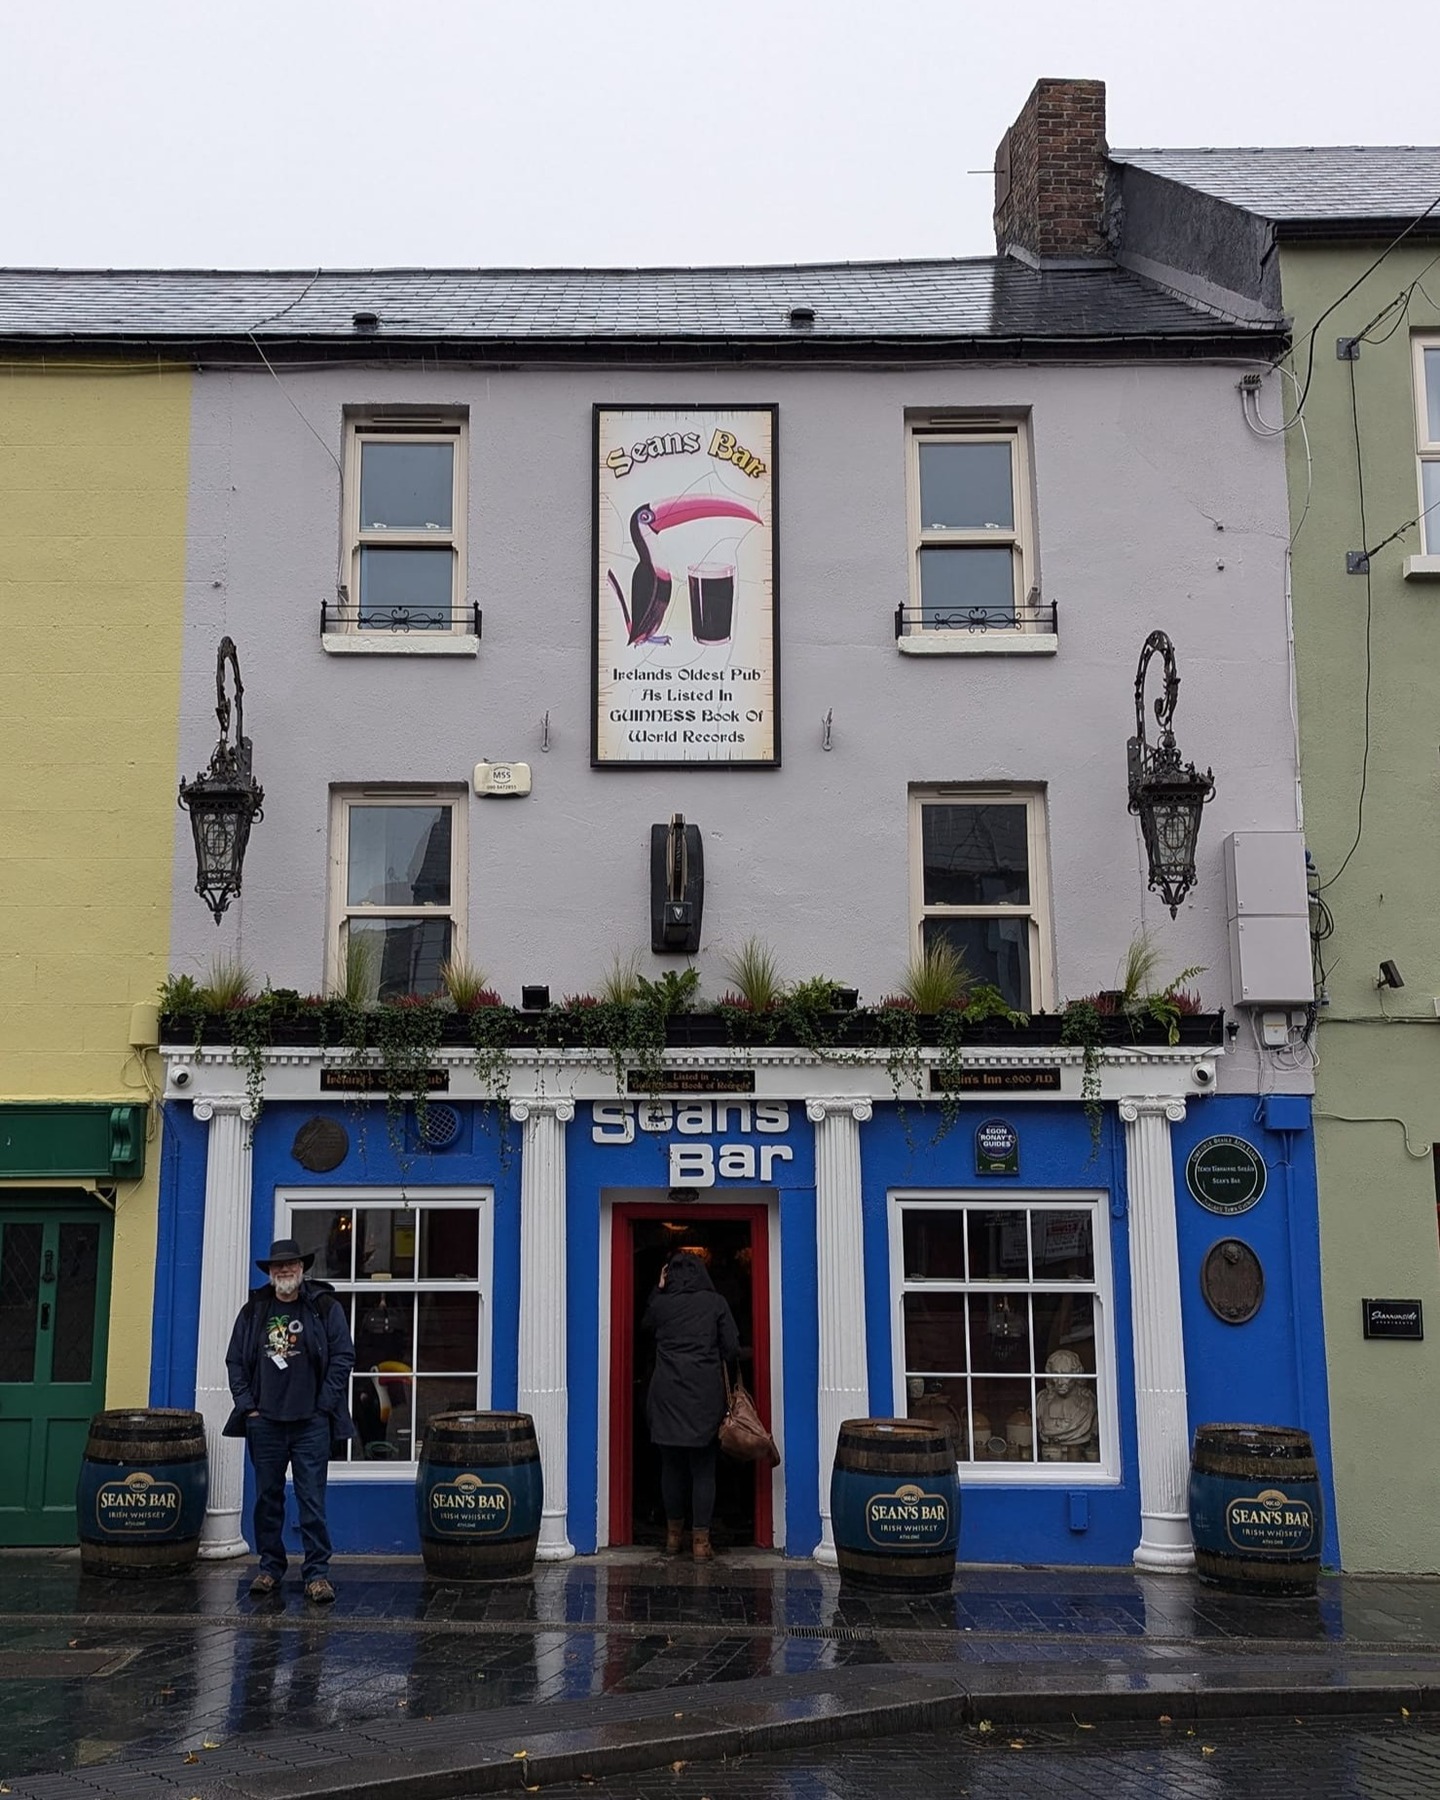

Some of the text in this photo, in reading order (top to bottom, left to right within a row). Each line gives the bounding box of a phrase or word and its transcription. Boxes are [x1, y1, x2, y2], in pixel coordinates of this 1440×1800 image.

[606, 428, 768, 479] Seans Bar
[613, 668, 761, 681] Irelands Oldest Pub
[641, 689, 733, 701] As Listed In
[610, 709, 764, 722] GUINNESS Book Of
[628, 730, 745, 743] World Records
[493, 771, 511, 779] MSS
[673, 1072, 698, 1080] Listed
[984, 1073, 1002, 1084] Inn
[681, 1082, 703, 1090] Book
[706, 1082, 714, 1090] of
[592, 1099, 789, 1144] Seans
[670, 1143, 793, 1188] Bar
[101, 1492, 176, 1508] SEAN'S BAR
[433, 1493, 505, 1510] SEAN'S BAR
[871, 1505, 945, 1521] SEAN'S BAR
[1232, 1508, 1309, 1528] SEAN'S BAR
[1242, 1528, 1303, 1537] IRISH WHISKEY
